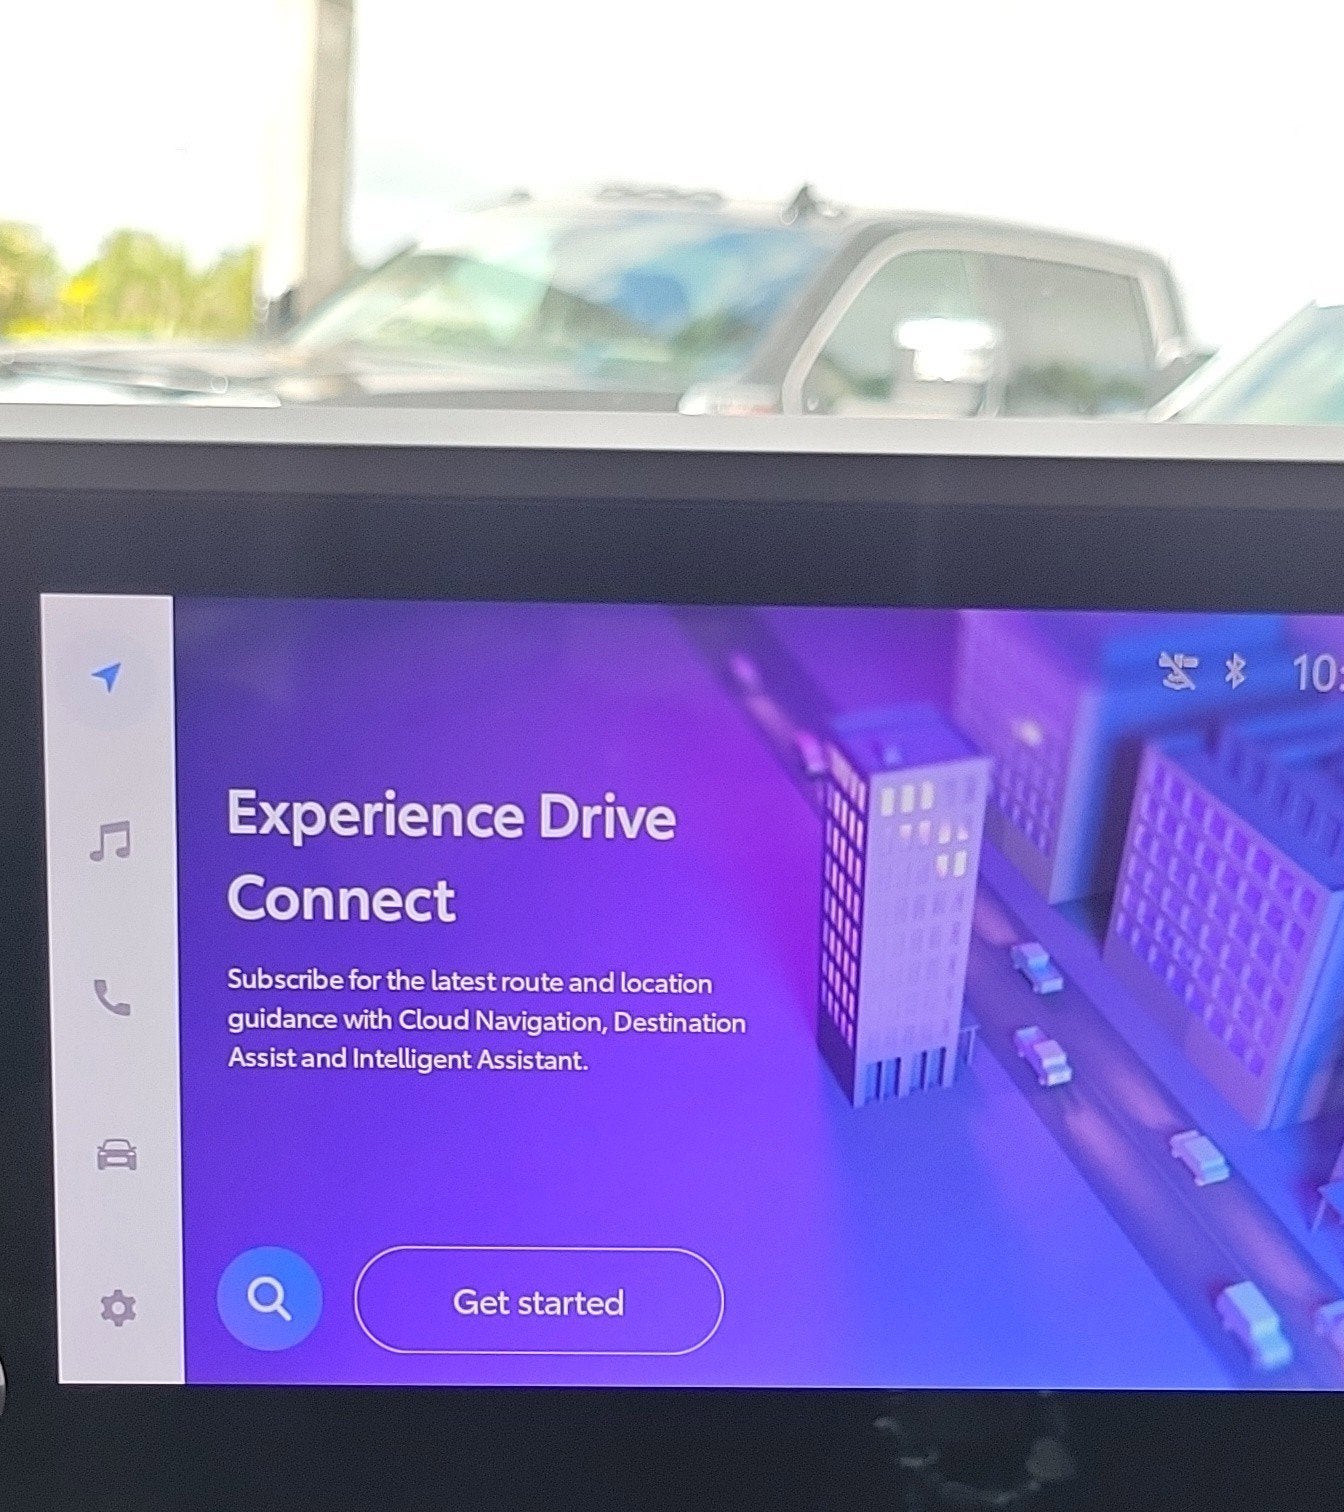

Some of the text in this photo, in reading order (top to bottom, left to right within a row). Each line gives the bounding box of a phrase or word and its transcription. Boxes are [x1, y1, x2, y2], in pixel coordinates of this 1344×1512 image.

[227, 788, 678, 847] Experience Drive
[227, 873, 458, 924] Connect
[227, 967, 713, 995] Subscribe for the latest route and location
[227, 1006, 747, 1037] guidance with Cloud Navigation, Destination
[227, 1046, 589, 1076] Assist and Intelligent Assistant.
[452, 1287, 625, 1317] Get started
